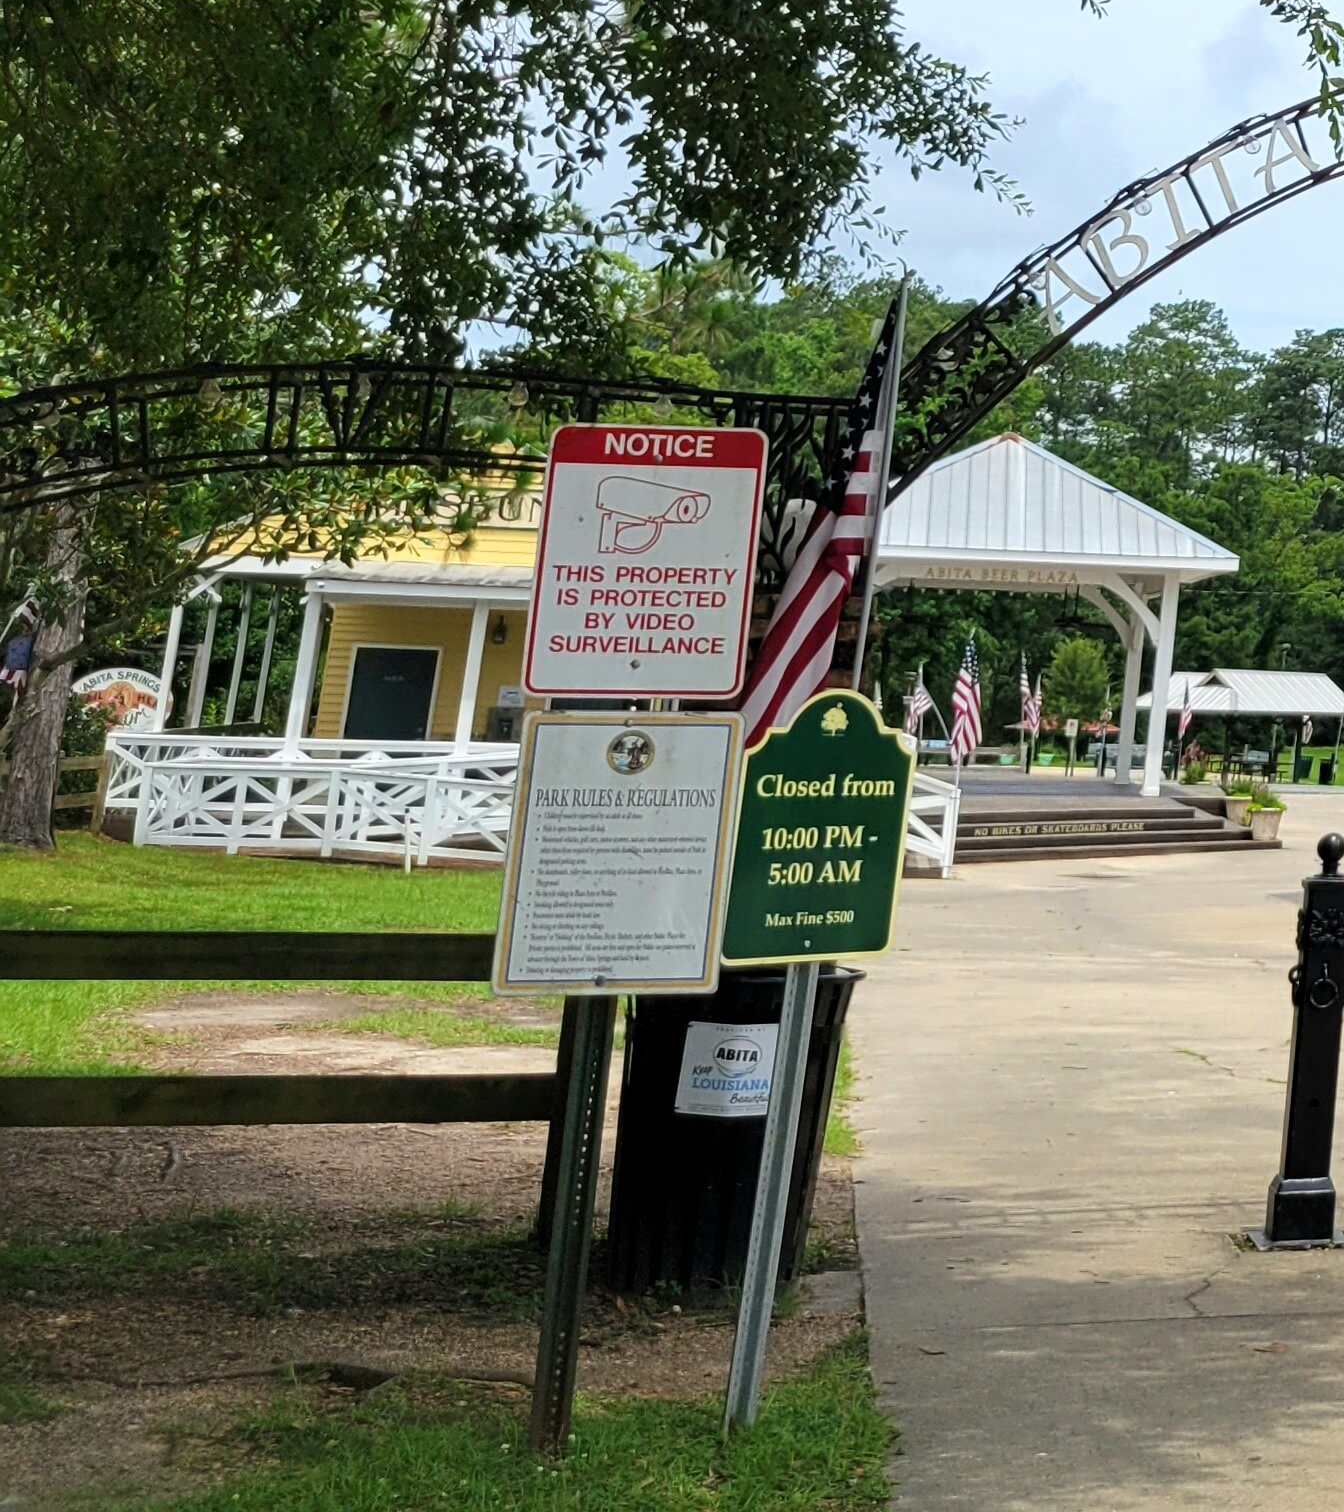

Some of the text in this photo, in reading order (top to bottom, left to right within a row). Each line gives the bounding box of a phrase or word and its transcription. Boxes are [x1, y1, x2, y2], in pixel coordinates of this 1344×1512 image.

[1035, 117, 1320, 336] ABITA
[604, 433, 715, 458] NOTICE
[552, 565, 738, 585] THIS PROPERTY
[926, 567, 1078, 583] ABITA BEER PLAZA
[557, 588, 727, 608] IS PROTECTED
[584, 612, 695, 631] BY VIDEO
[549, 635, 725, 654] SURVEILLANCE
[82, 670, 161, 693] ABITA SPRINGS
[757, 773, 896, 797] Closed from
[535, 789, 717, 807] PARK RULES & REGULATIONS
[760, 826, 819, 850] 10:00
[823, 825, 865, 848] PM
[974, 822, 1145, 836] NO BIKES OR SKATEBOARDS PLEASE
[767, 859, 864, 886] 5:00 AM
[765, 909, 855, 927] Max Fine $500
[716, 1047, 758, 1062] ABITA
[692, 1077, 769, 1091] LOUISIANA
